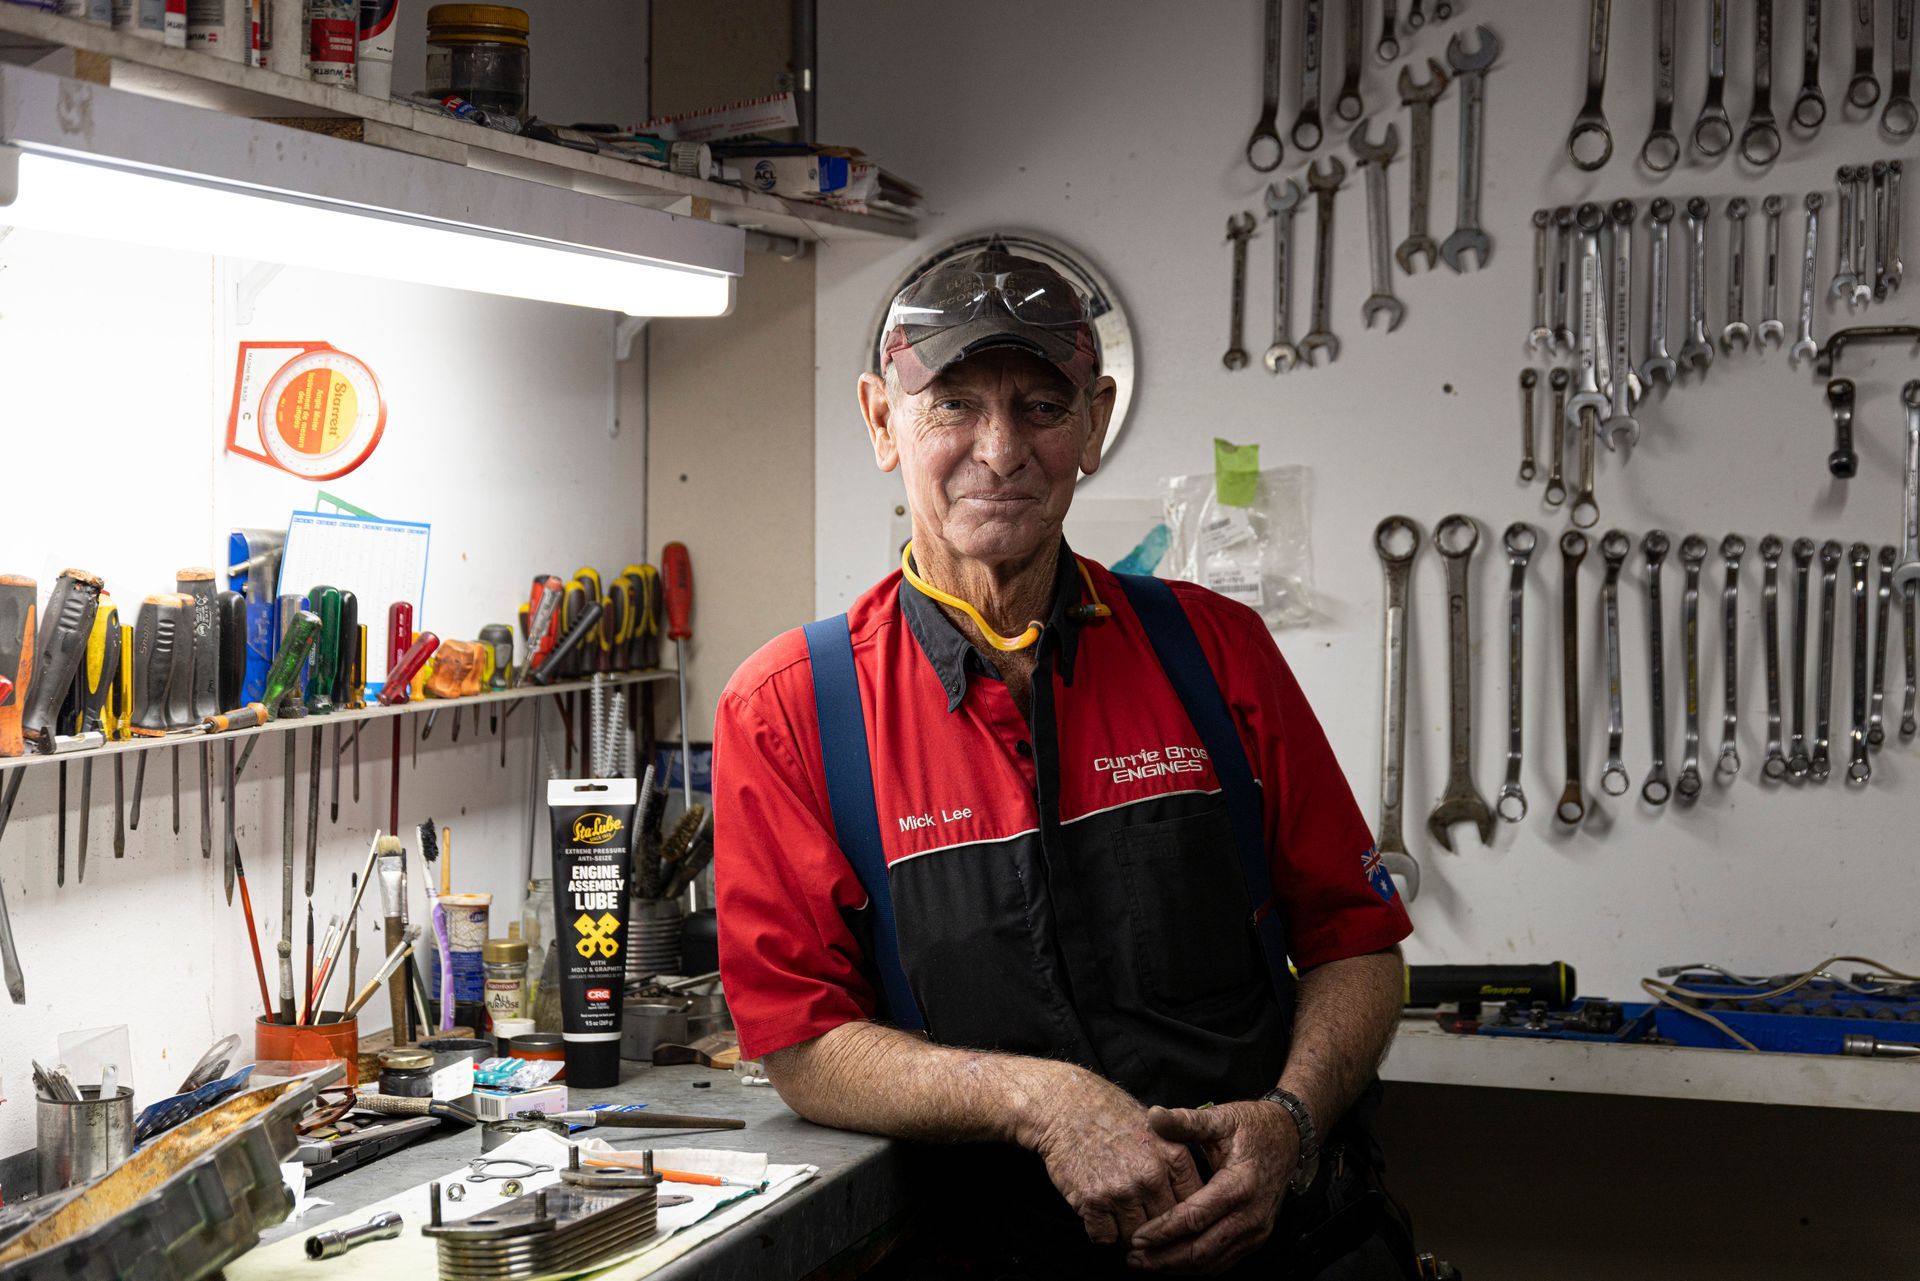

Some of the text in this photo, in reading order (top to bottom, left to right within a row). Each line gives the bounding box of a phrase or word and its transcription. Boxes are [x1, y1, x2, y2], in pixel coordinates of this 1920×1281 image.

[755, 171, 776, 181] ACL
[329, 382, 347, 436] Starrett
[1094, 746, 1208, 771] Currie Bros
[1112, 760, 1203, 784] ENGINES
[899, 808, 972, 832] Mick Lee
[572, 865, 620, 880] ENGINE
[568, 879, 625, 892] ASSEMBLY
[575, 892, 618, 910] LUBE
[487, 1000, 519, 1009] PURPOSE
